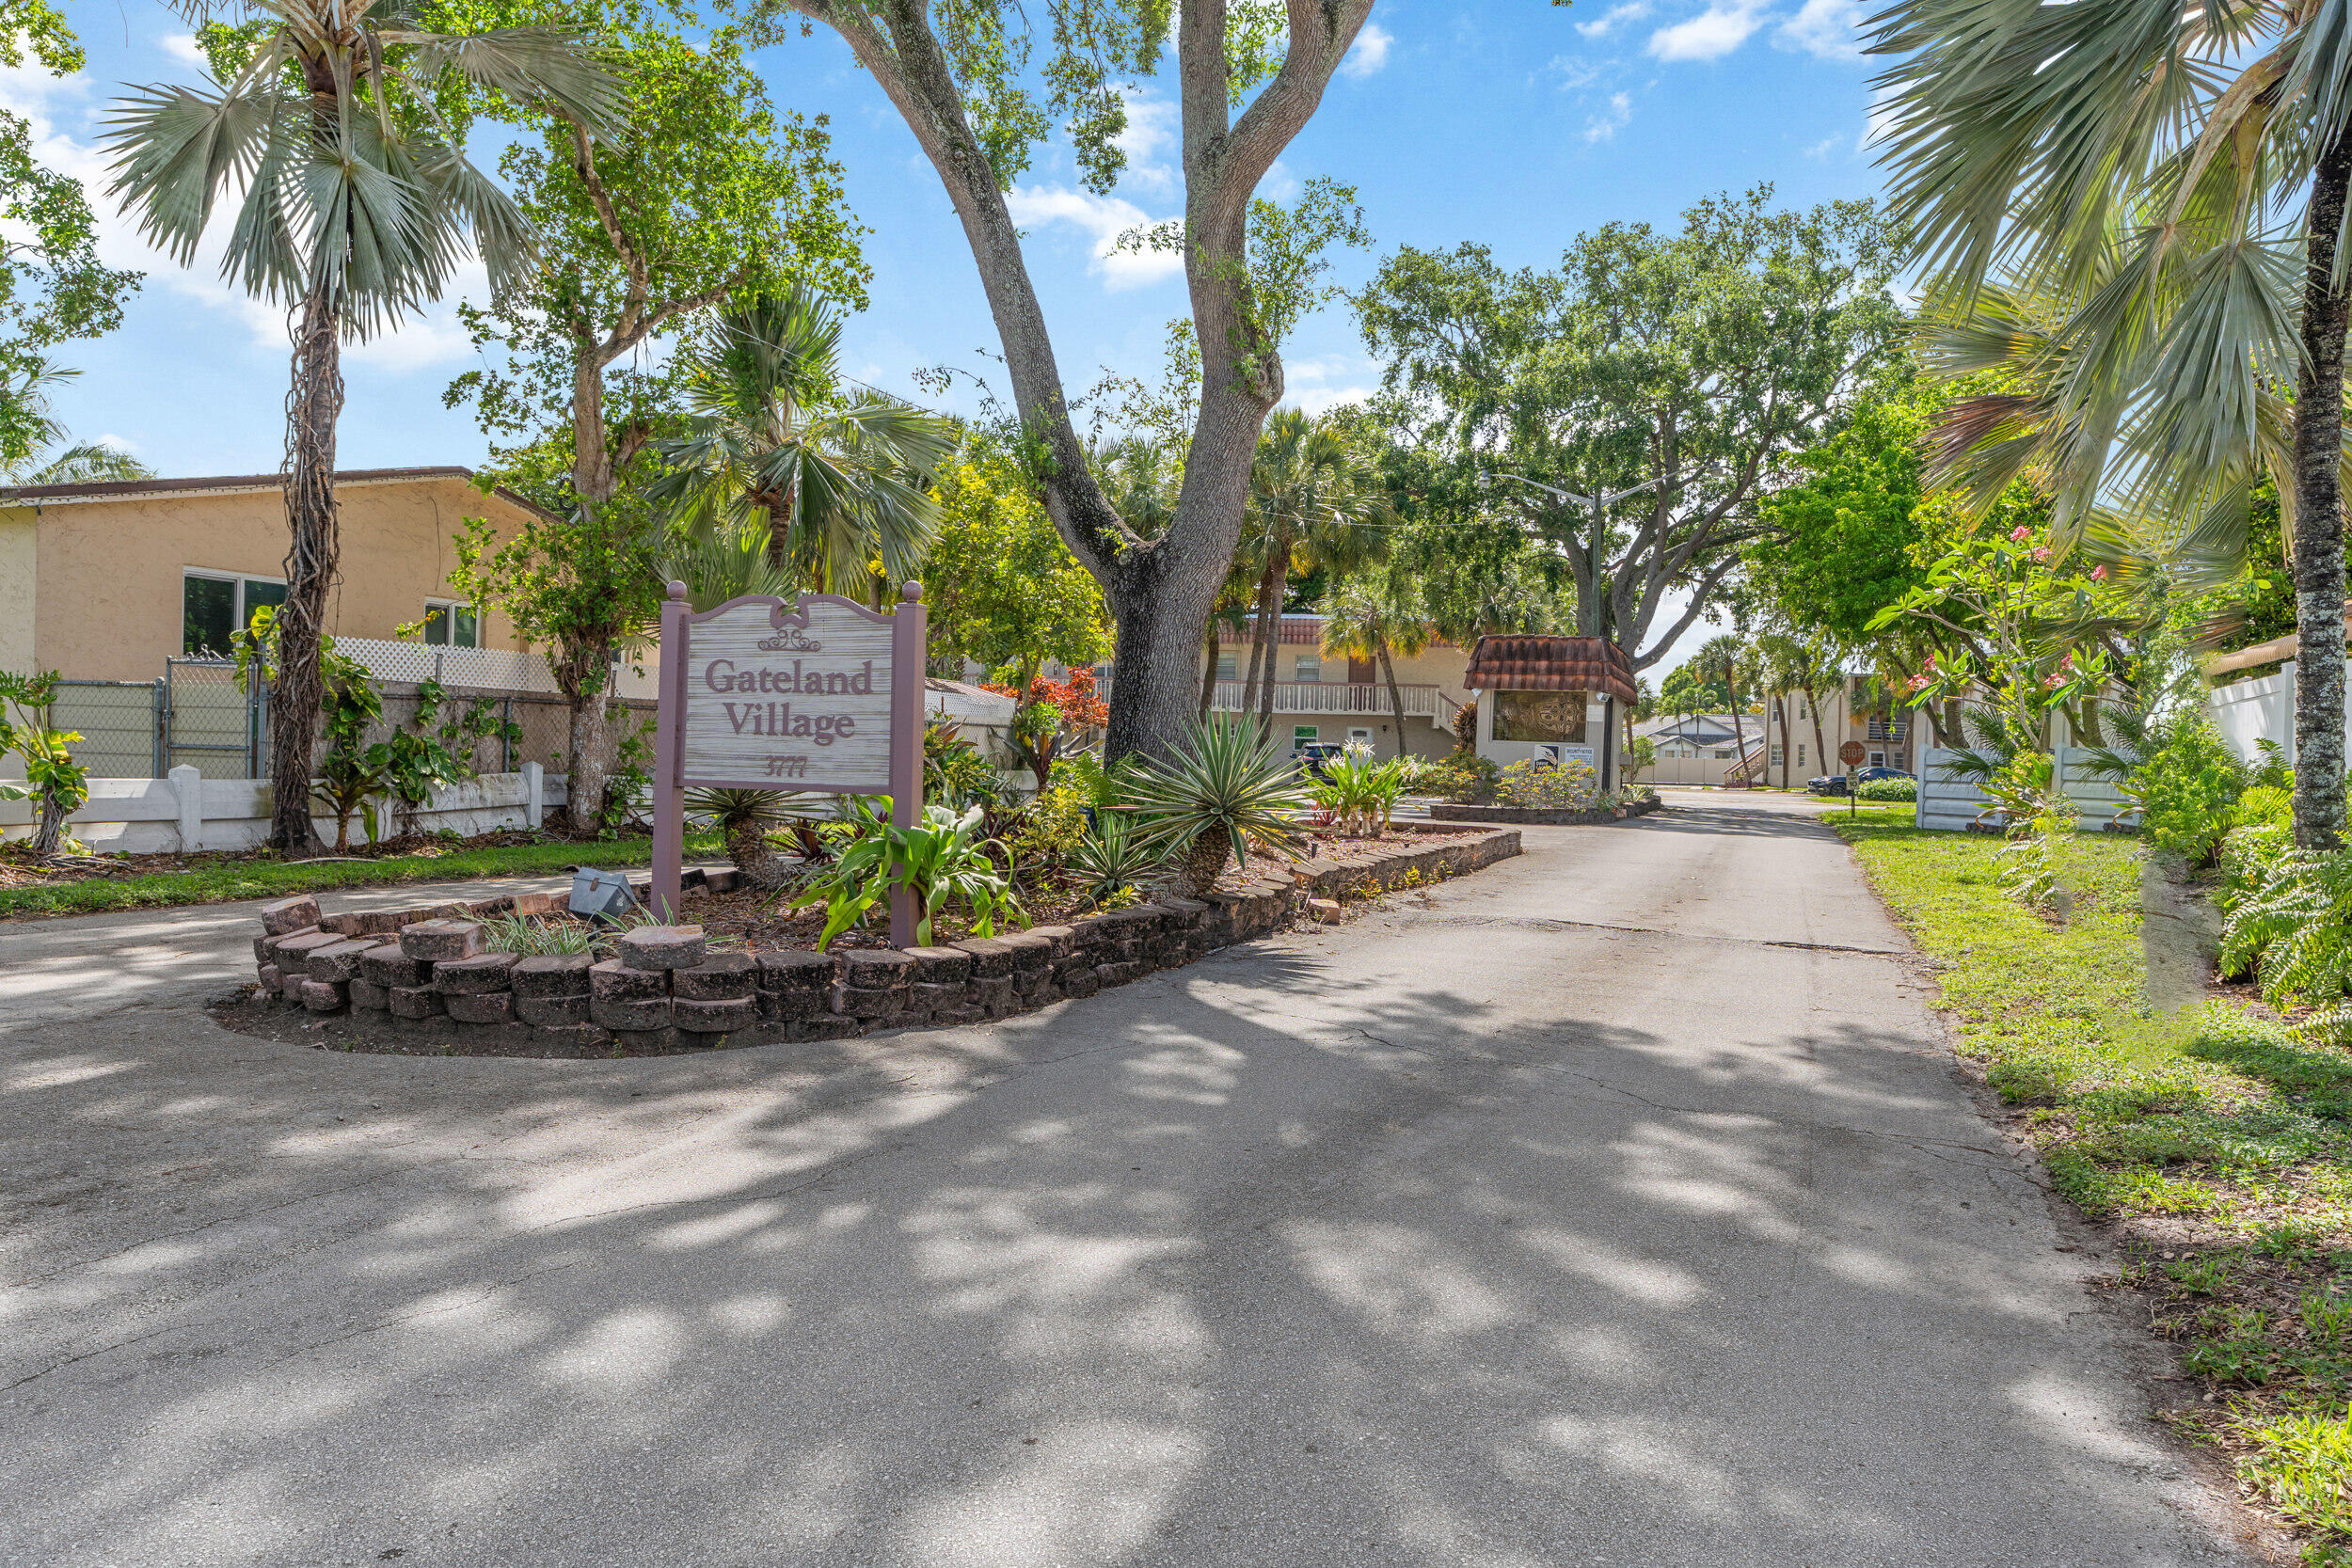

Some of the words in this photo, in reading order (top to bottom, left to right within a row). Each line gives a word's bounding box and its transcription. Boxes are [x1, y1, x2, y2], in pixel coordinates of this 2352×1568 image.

[706, 658, 873, 694] Gateland
[723, 702, 855, 746] Village
[765, 755, 807, 777] 3777
[1841, 749, 1863, 758] STOP
